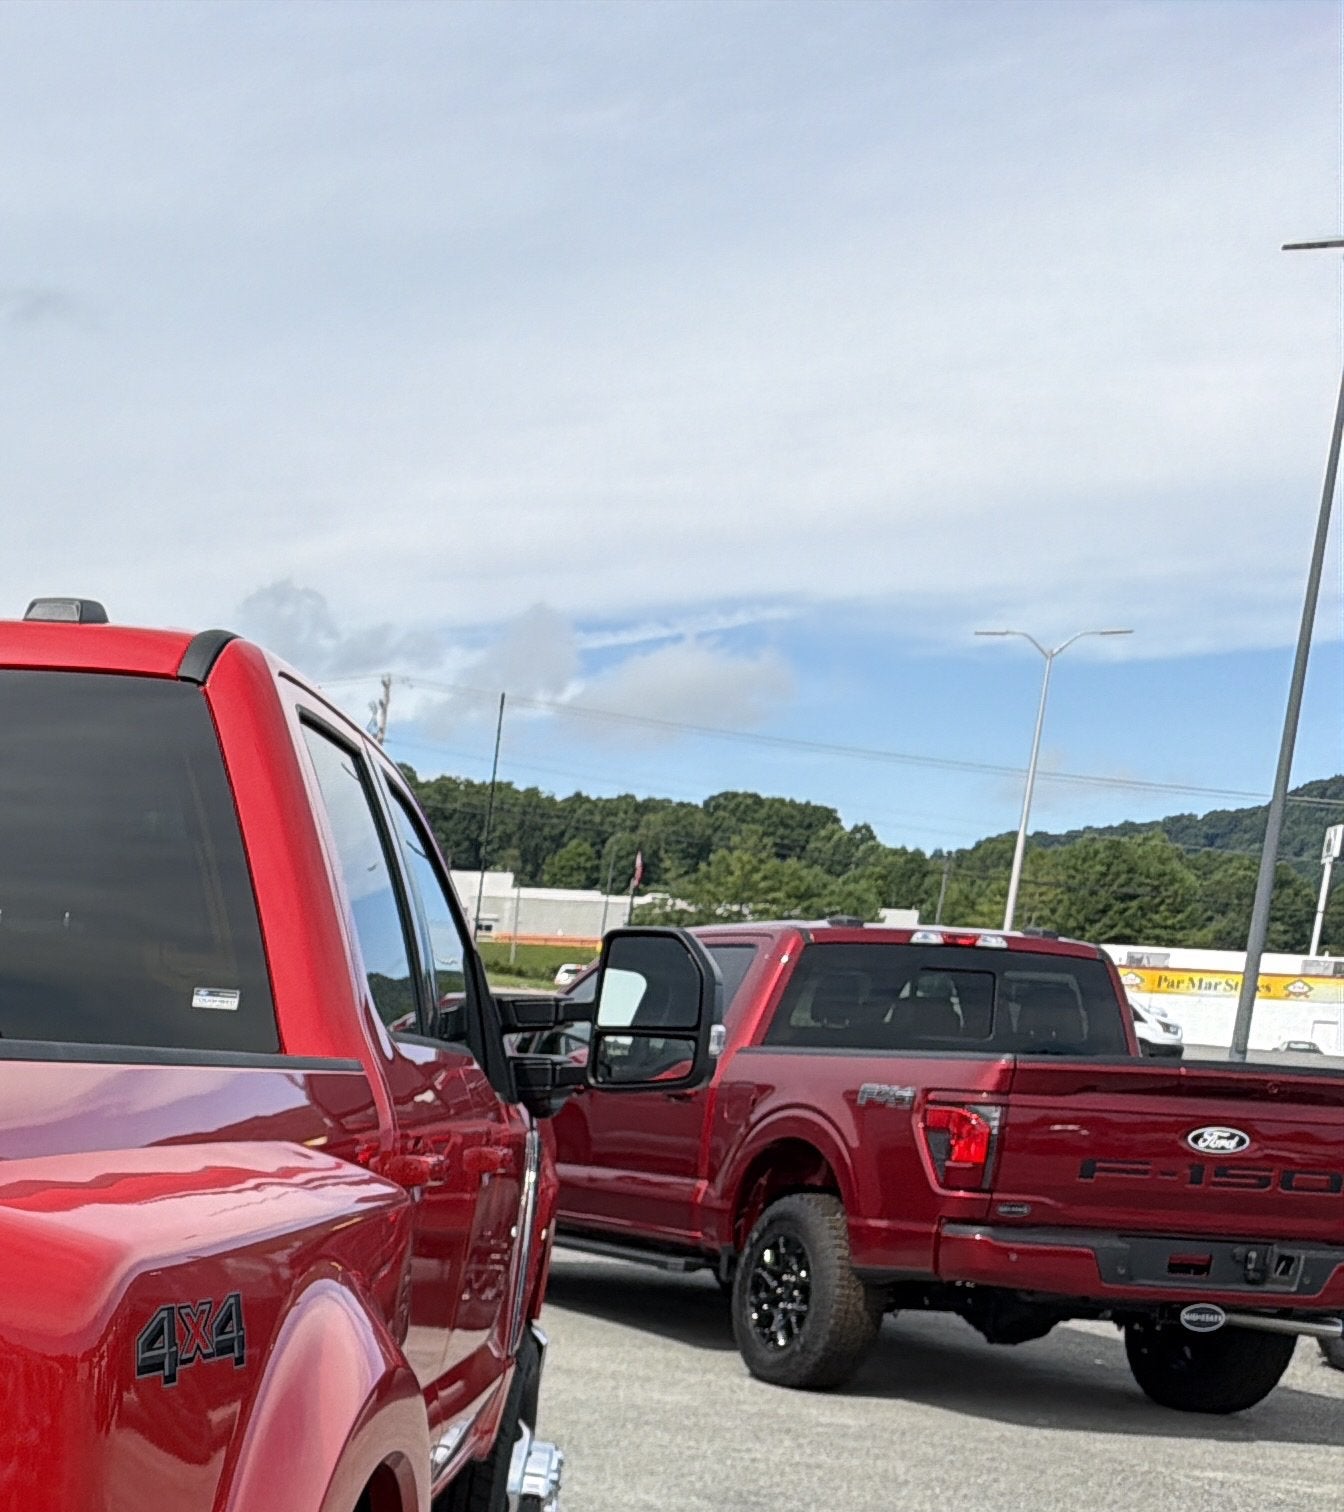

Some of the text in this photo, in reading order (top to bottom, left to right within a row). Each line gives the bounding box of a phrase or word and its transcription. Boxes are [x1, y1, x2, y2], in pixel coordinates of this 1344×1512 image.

[1157, 975, 1272, 993] Par Mar Stes
[1198, 1130, 1240, 1149] Ford
[1078, 1158, 1344, 1195] F-150
